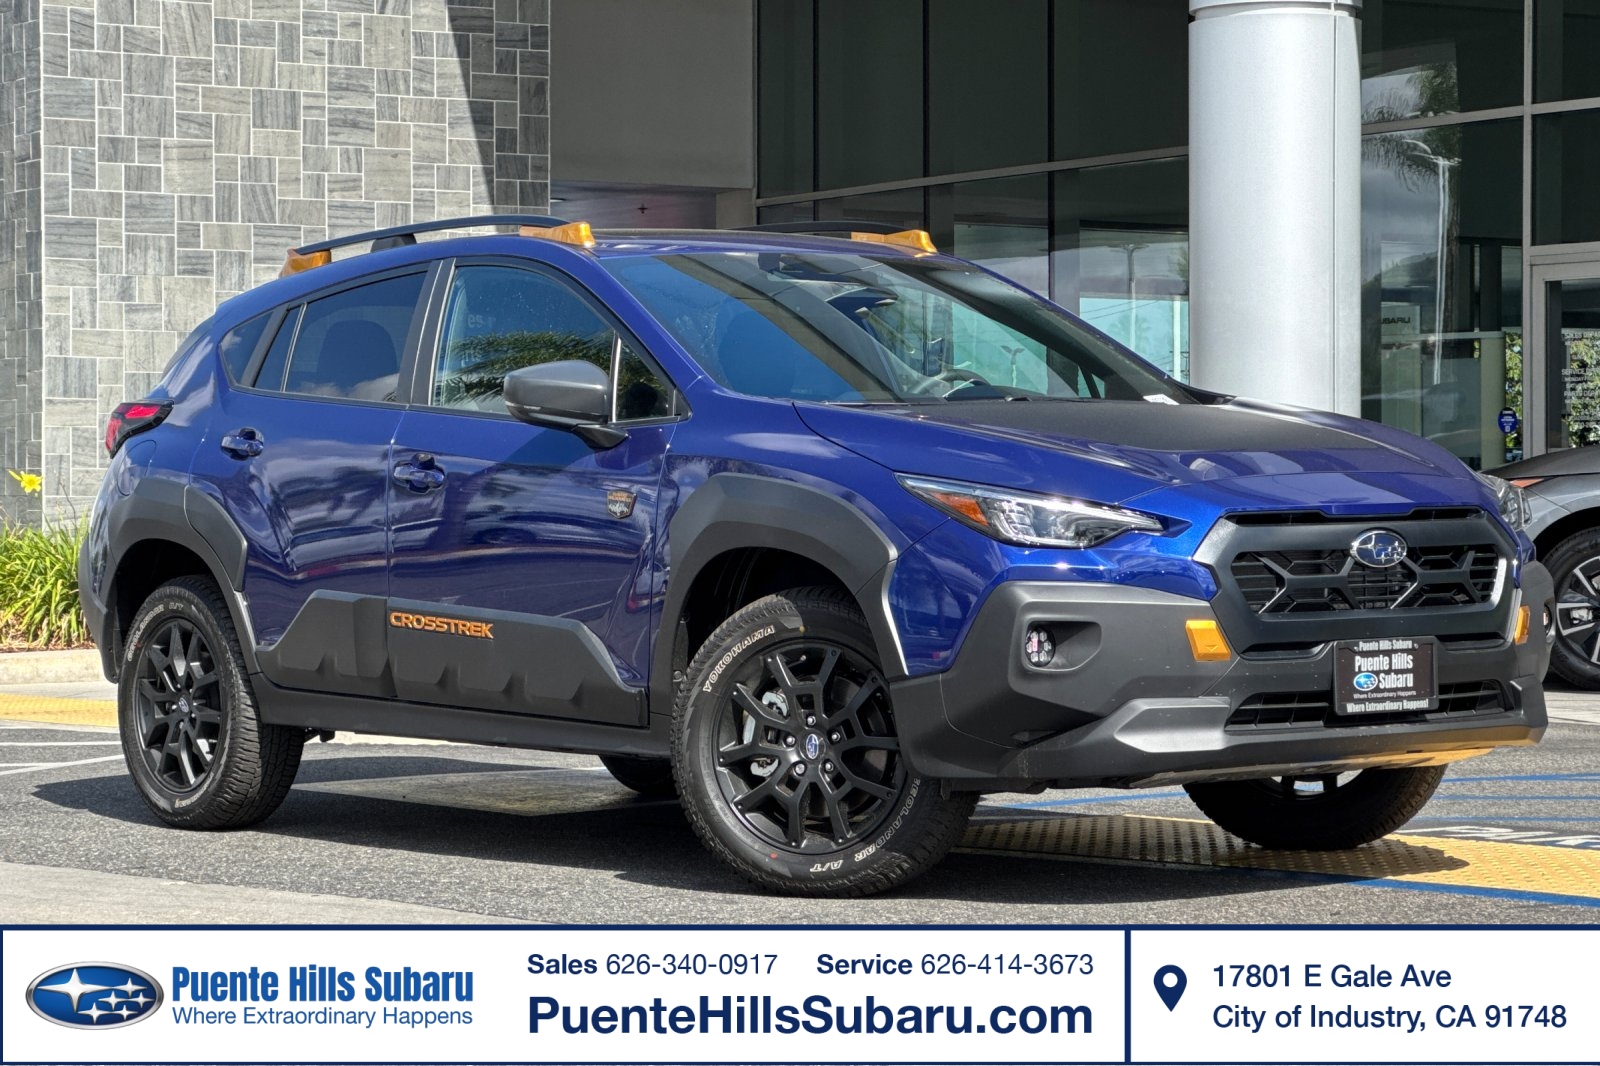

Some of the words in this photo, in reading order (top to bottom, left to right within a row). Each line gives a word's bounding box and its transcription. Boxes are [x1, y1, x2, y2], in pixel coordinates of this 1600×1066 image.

[389, 611, 494, 639] CROSSTREK
[1359, 641, 1379, 652] Puente
[1379, 640, 1392, 650] Hills
[1392, 639, 1413, 649] Subaru
[702, 625, 775, 693] YOKOHAMA
[1354, 654, 1390, 672] Puente
[1391, 652, 1414, 670] Hills
[1378, 672, 1414, 689] Subaru
[1367, 691, 1397, 699] Extraordinary
[1346, 702, 1365, 713] Where
[1365, 700, 1403, 712] Extraordinary
[1403, 698, 1429, 710] Happens!
[810, 859, 844, 873] A/T
